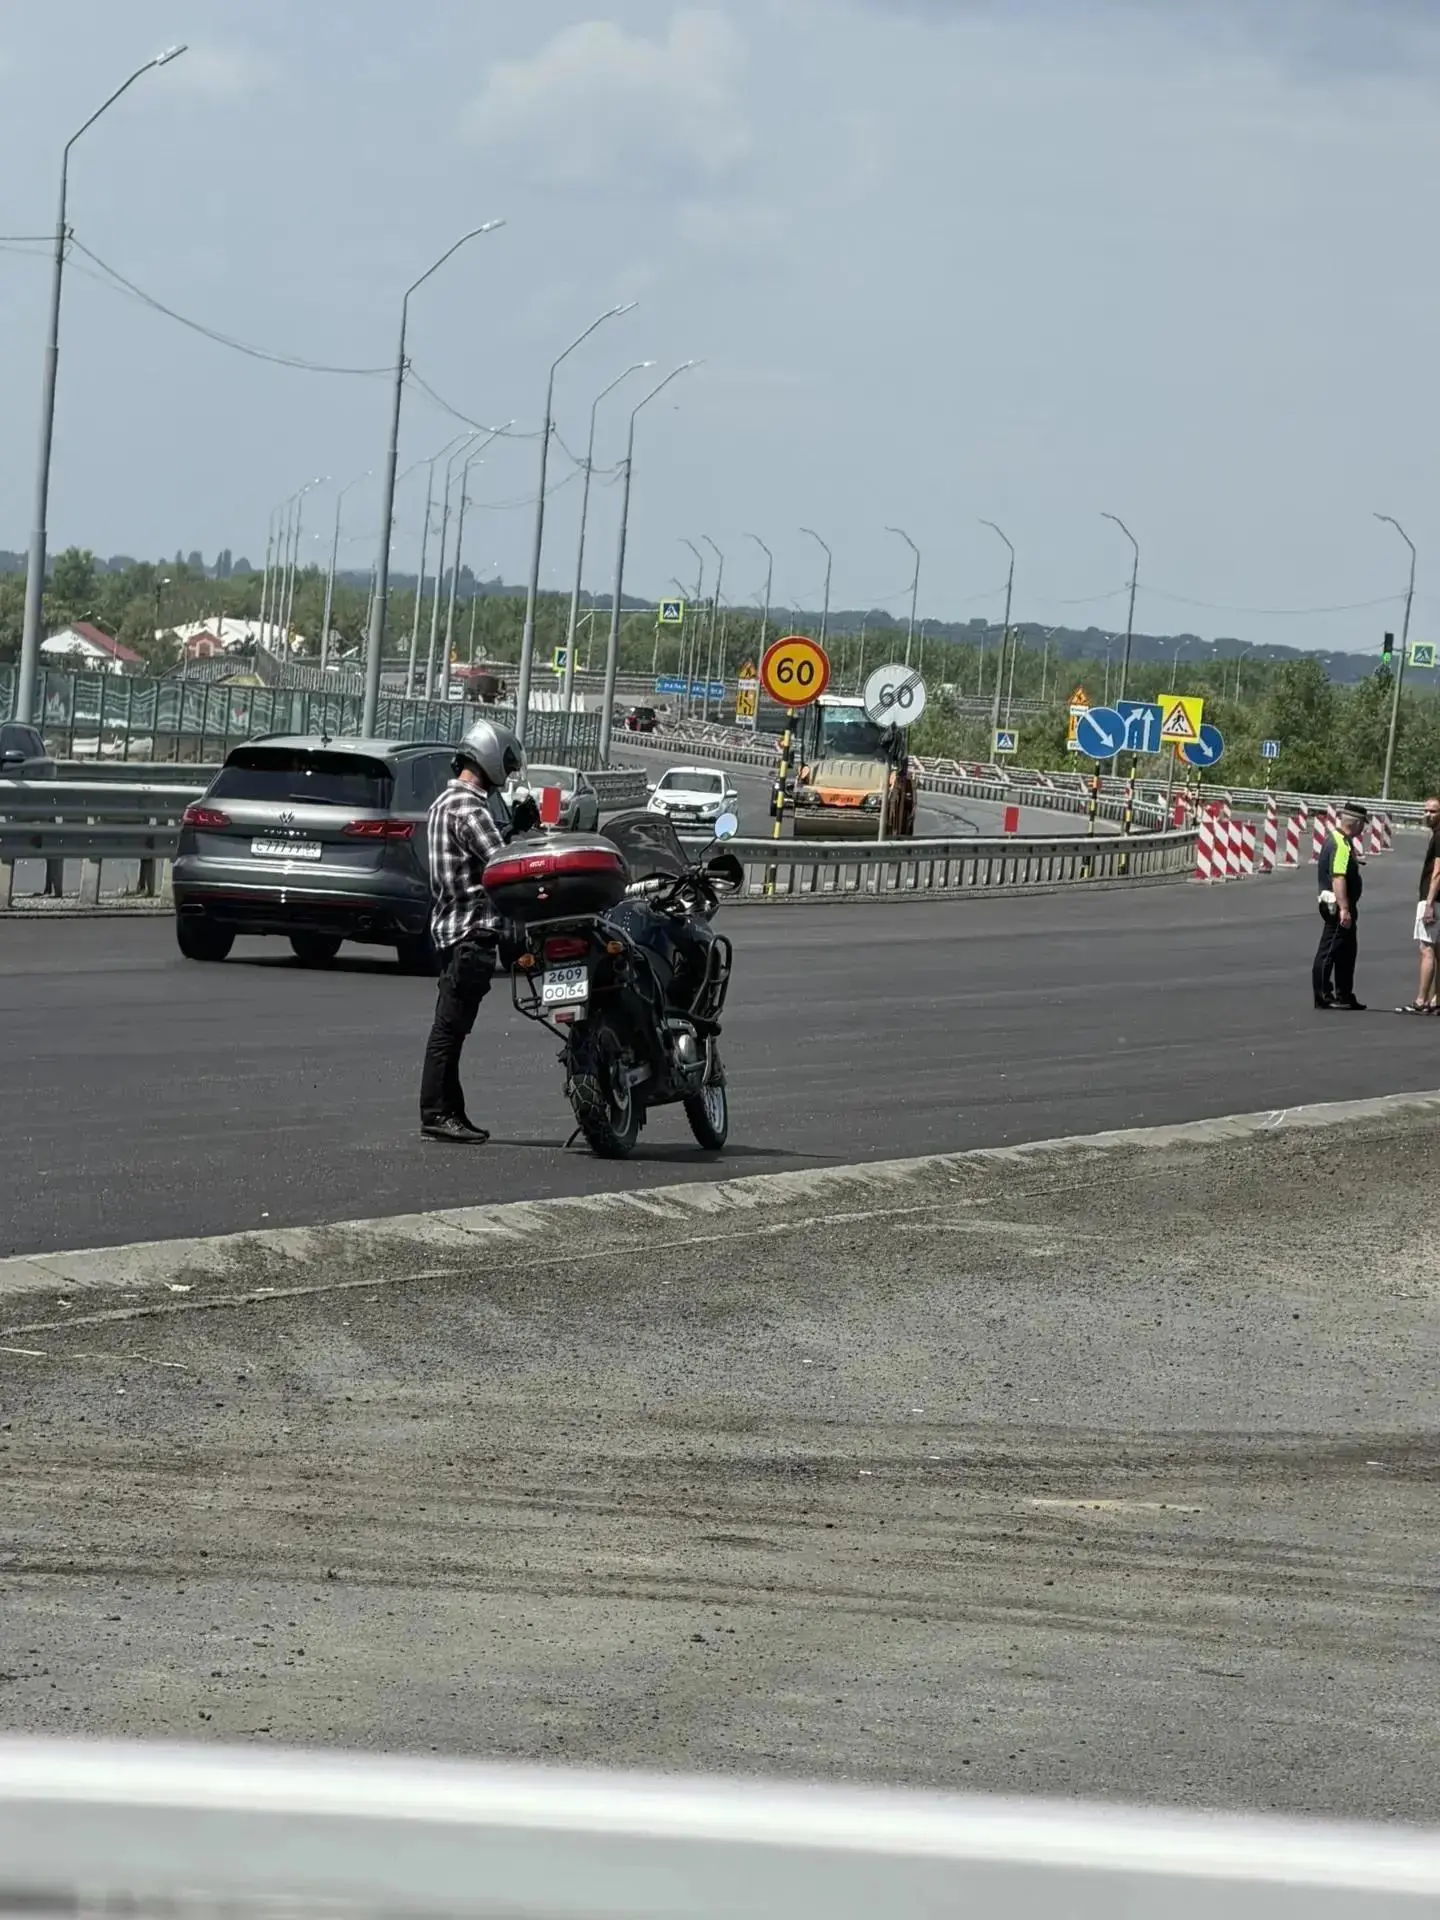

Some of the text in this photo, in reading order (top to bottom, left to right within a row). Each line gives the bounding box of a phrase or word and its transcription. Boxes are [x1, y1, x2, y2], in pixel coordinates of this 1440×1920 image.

[777, 657, 814, 686] 60
[879, 683, 914, 708] 60
[548, 968, 582, 983] 2609
